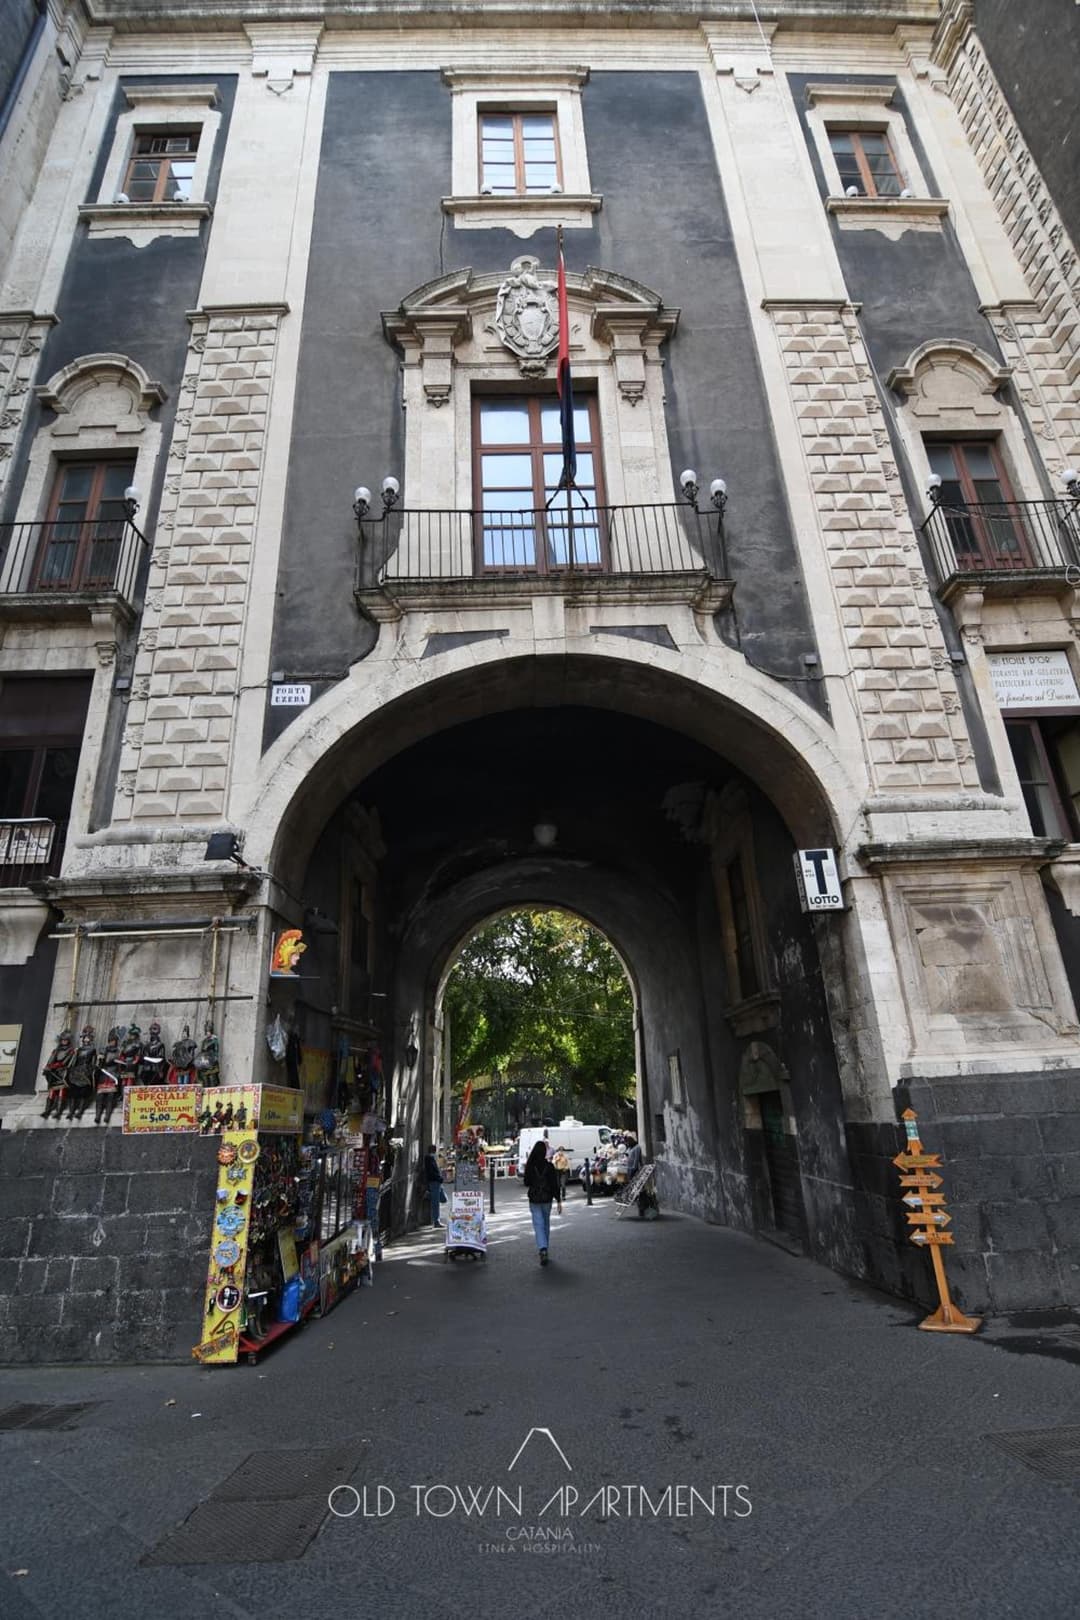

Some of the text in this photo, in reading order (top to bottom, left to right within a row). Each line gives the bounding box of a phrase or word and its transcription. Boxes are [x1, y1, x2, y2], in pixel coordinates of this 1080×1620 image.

[804, 850, 829, 895] T
[809, 895, 840, 905] LOTTO
[136, 1092, 189, 1101] SPECIALE
